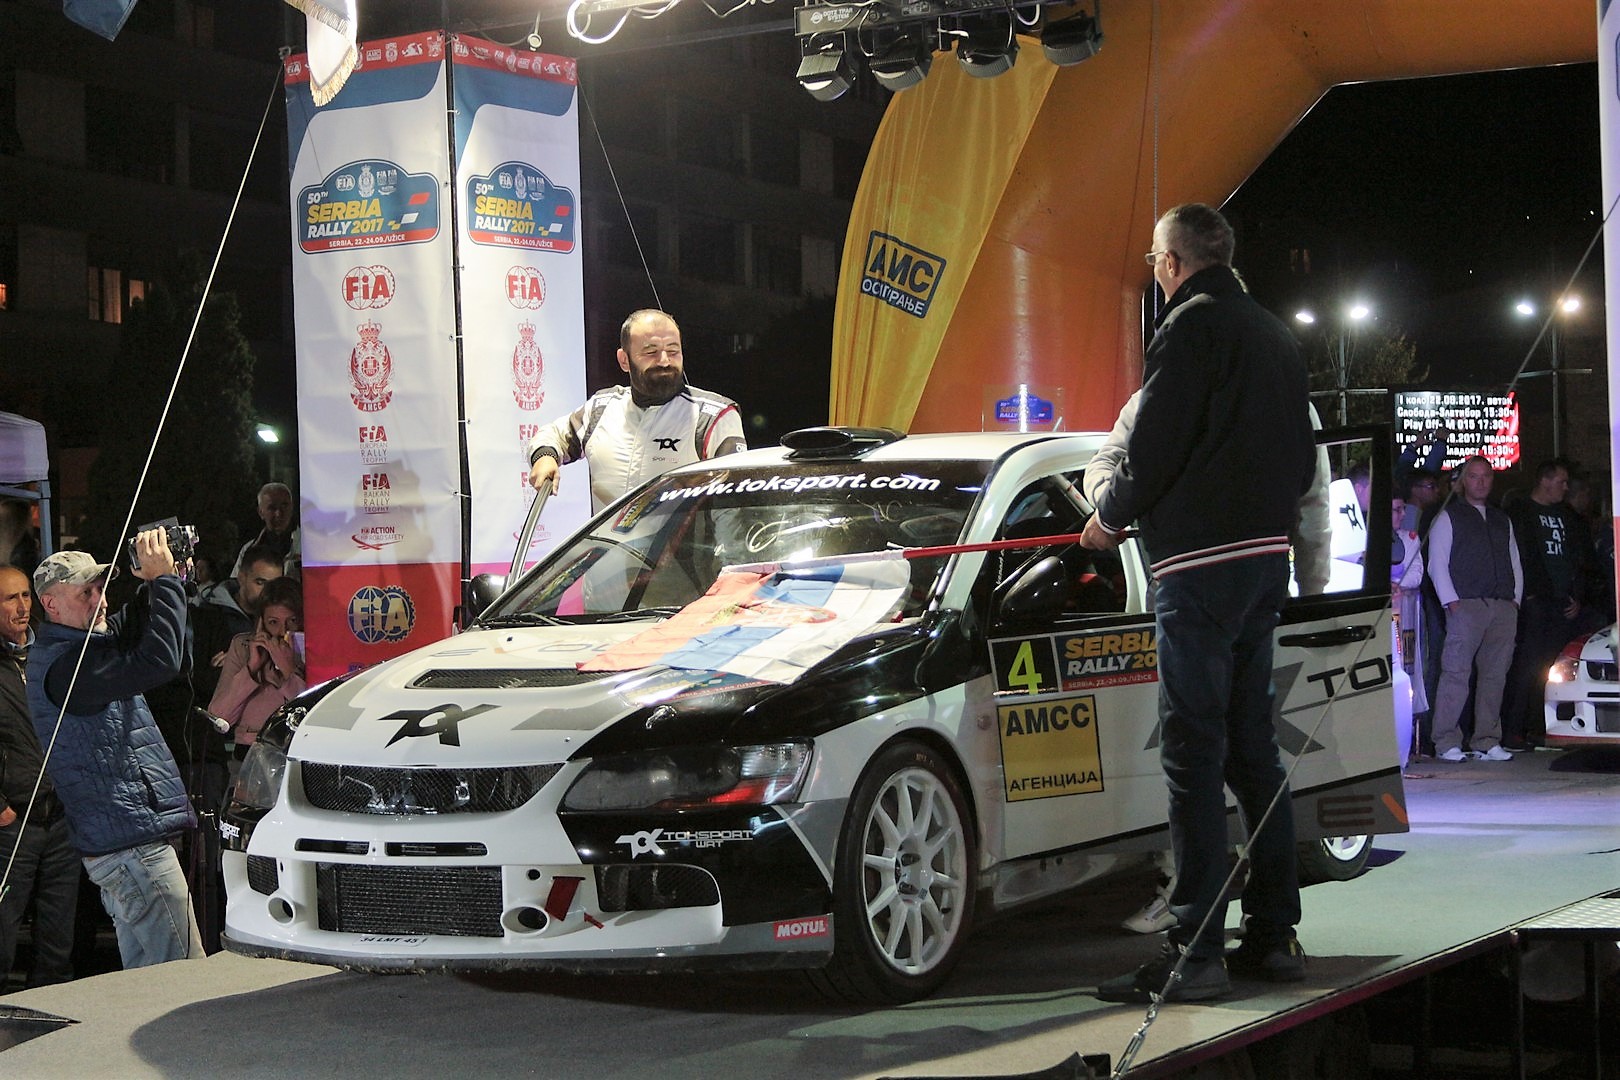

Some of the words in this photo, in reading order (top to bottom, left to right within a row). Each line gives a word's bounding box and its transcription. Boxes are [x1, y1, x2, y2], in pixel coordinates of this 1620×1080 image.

[307, 198, 382, 224] SERBIA
[474, 196, 534, 220] SERBIA
[308, 221, 352, 238] RALLY
[350, 218, 384, 234] 2017
[474, 216, 512, 232] RALLY
[510, 220, 536, 234] 2017
[329, 239, 354, 248] SERBIA,
[361, 449, 387, 458] RALLY
[364, 490, 390, 498] BALKAN
[659, 472, 941, 503] www.toksport.com
[364, 498, 390, 506] RALLY
[370, 526, 395, 534] ACTION
[1008, 640, 1042, 694] 4
[1067, 654, 1132, 676] RALLY
[1132, 652, 1158, 669] 20
[1006, 703, 1090, 736] АМСС
[1010, 770, 1098, 792] АГЕНЦИЈА
[664, 830, 752, 840] TOKSPORT
[777, 920, 826, 937] MOTUL
